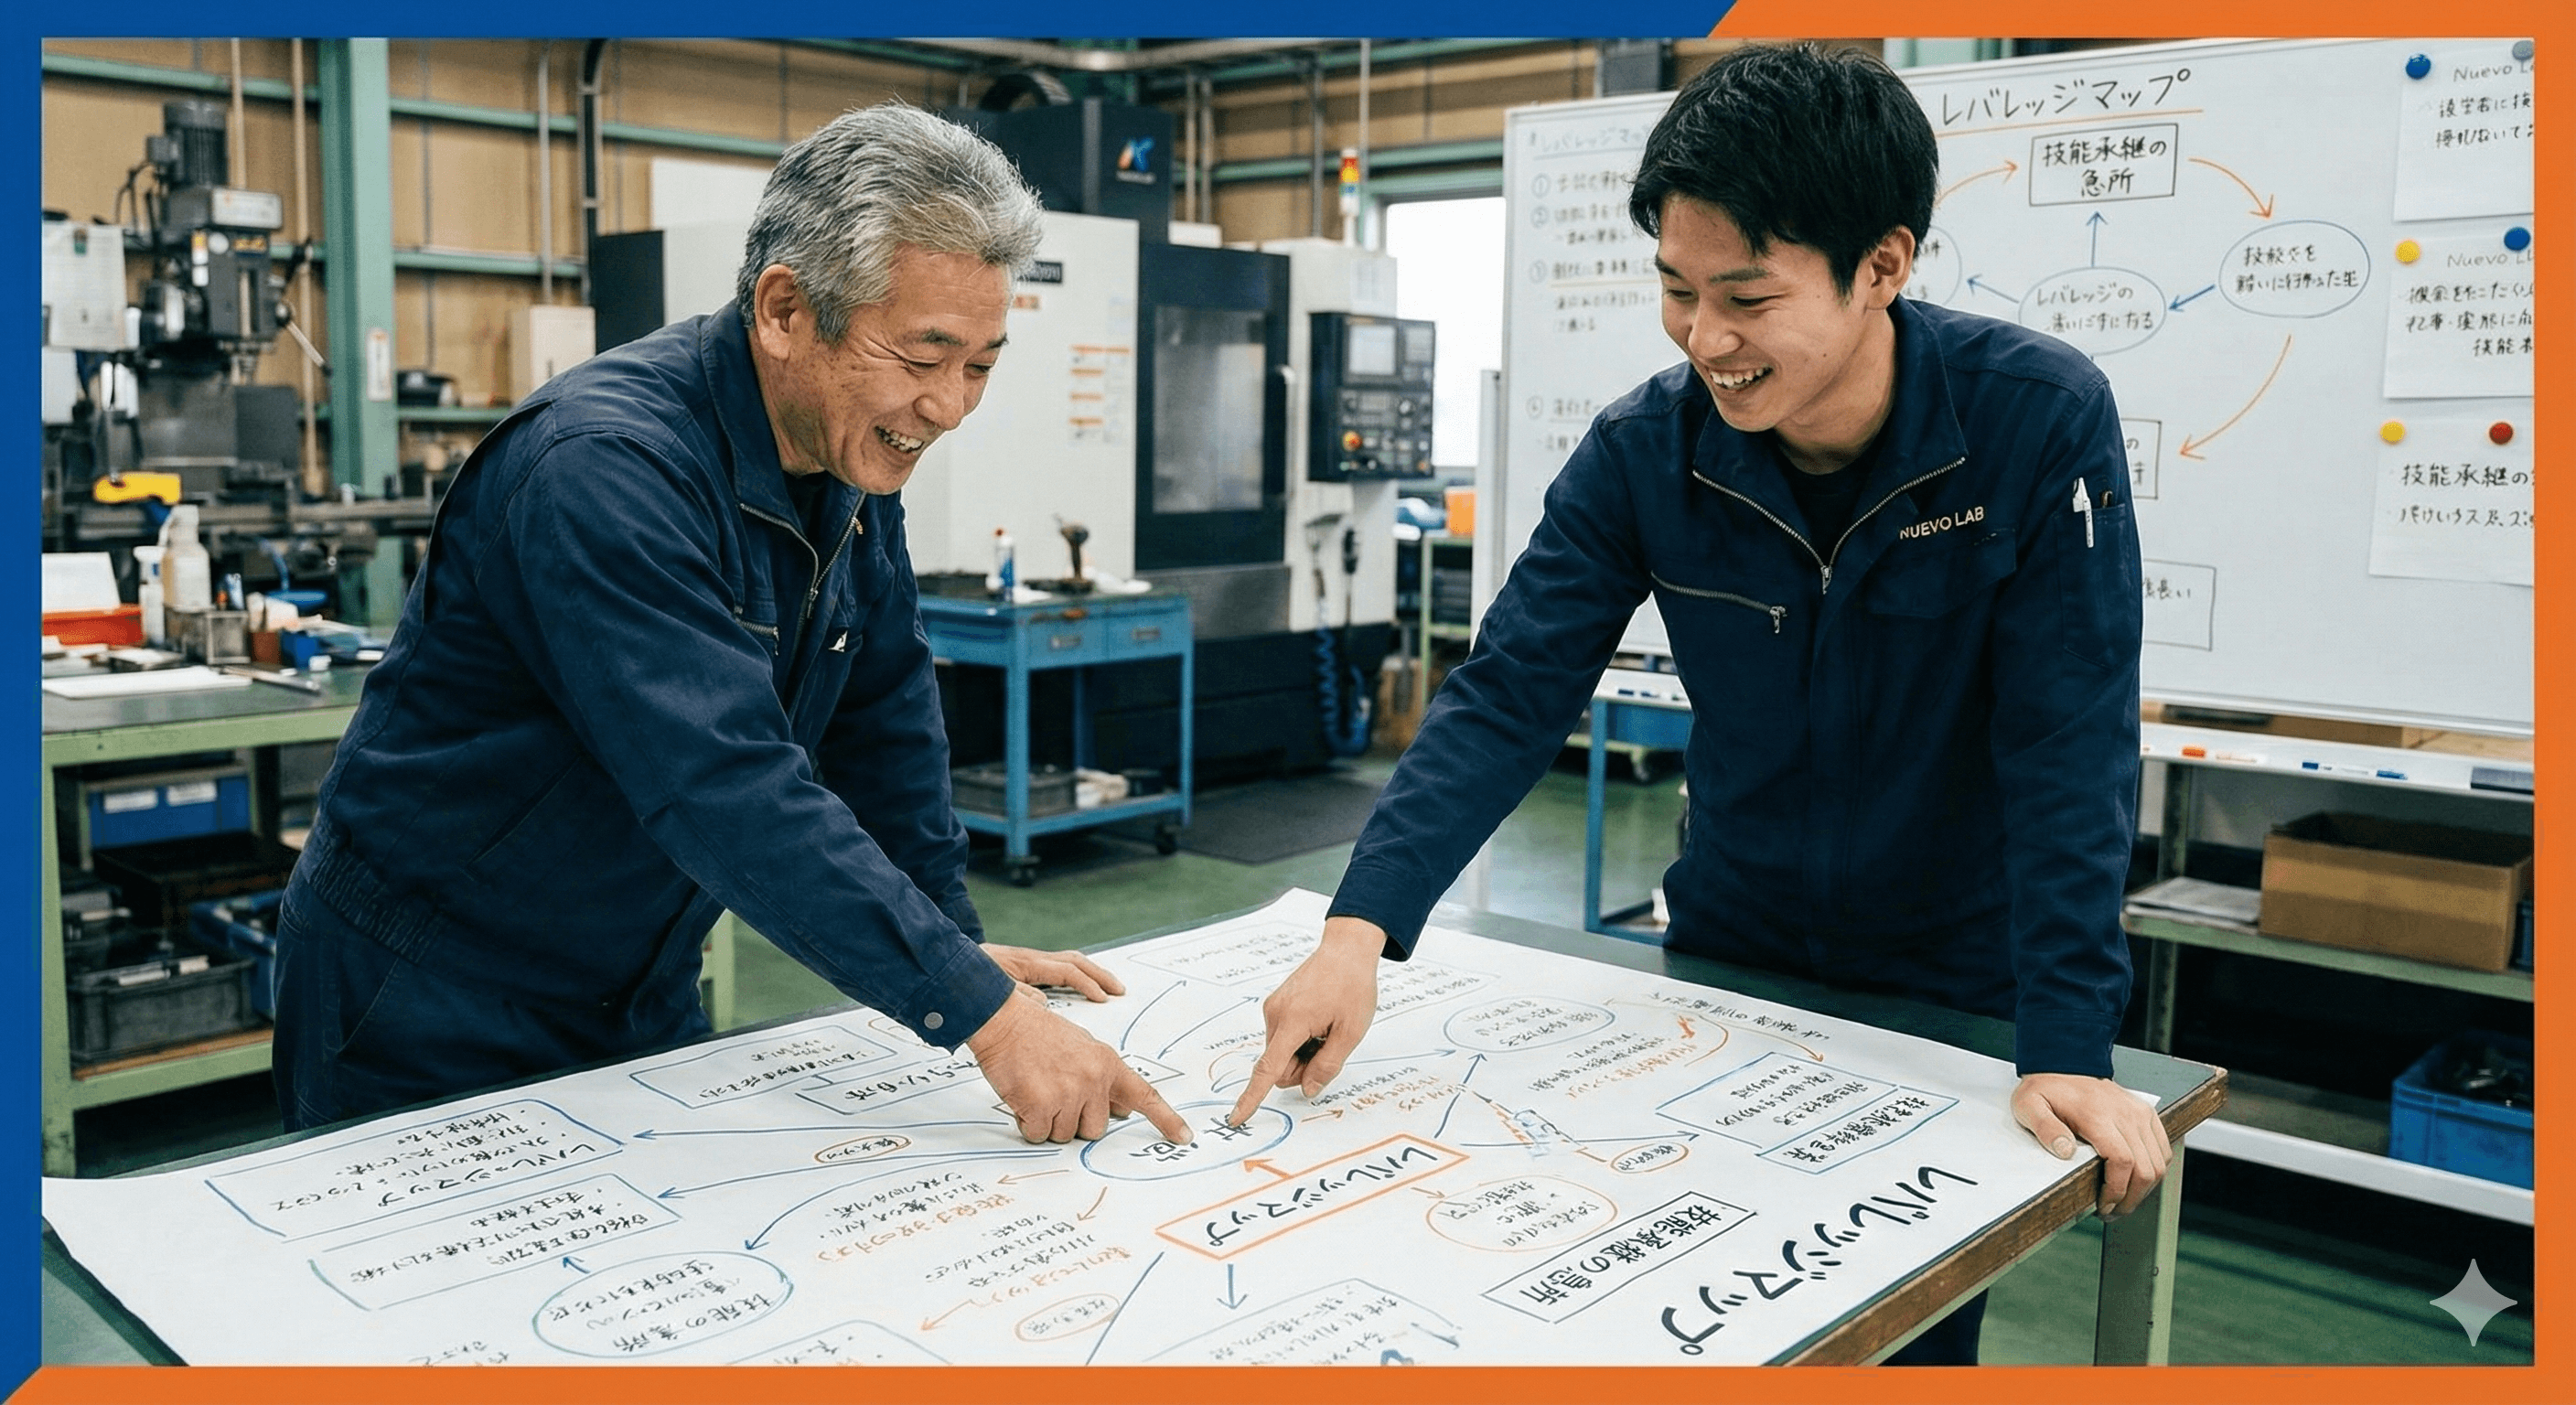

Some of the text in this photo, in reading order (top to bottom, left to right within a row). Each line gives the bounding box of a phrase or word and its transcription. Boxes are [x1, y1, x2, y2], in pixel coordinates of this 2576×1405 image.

[2453, 65, 2513, 81] Nuevo
[1943, 68, 2191, 125] レバレッジマップ
[2042, 136, 2167, 166] 技能承継の
[2081, 167, 2135, 197] 急所
[2447, 253, 2508, 267] Nuevo
[2036, 283, 2133, 306] レバレッジの
[2401, 463, 2535, 487] 技能承継の
[1899, 506, 1984, 540] NUEVO LAB
